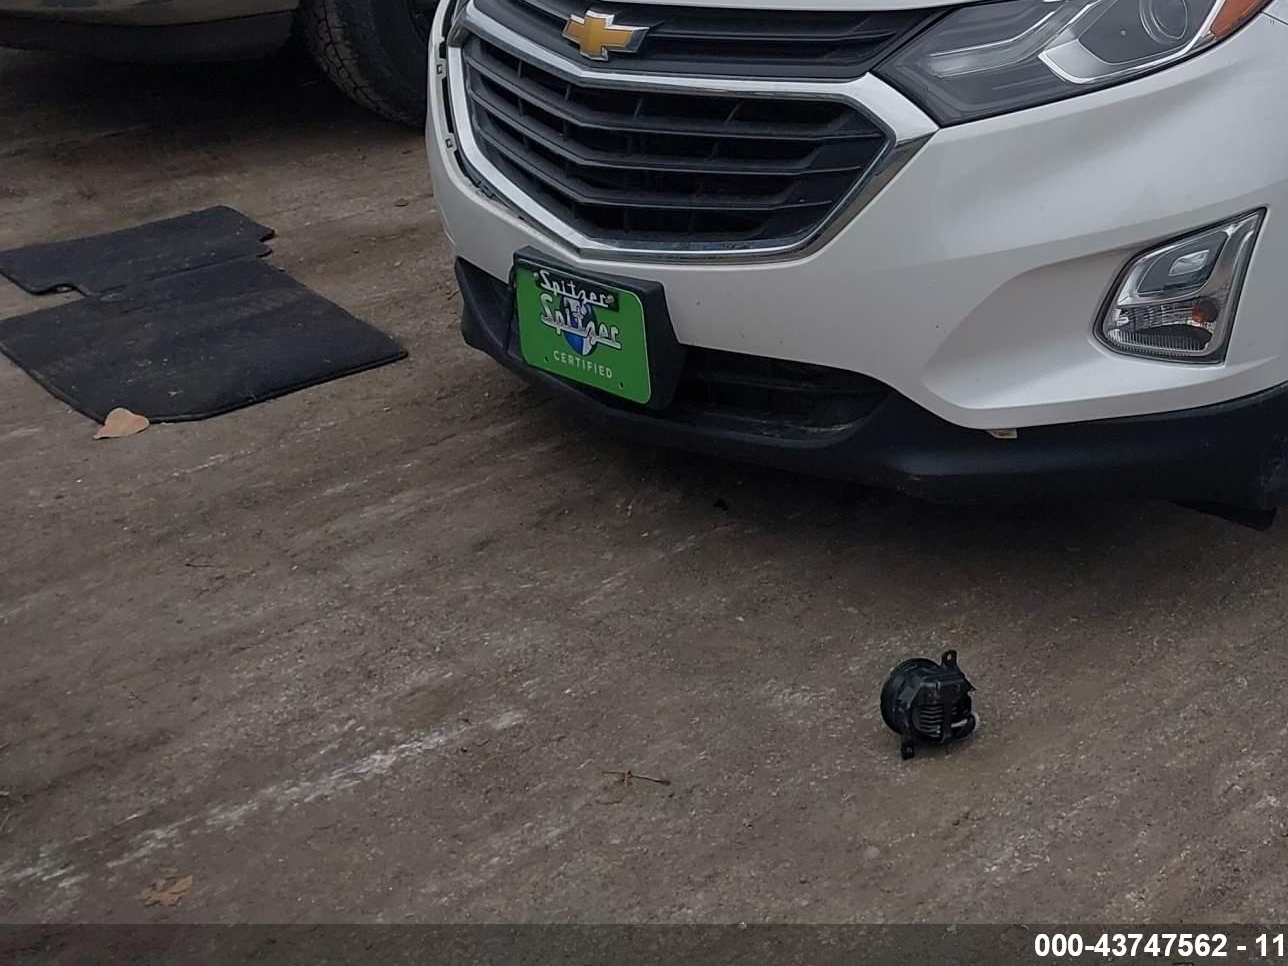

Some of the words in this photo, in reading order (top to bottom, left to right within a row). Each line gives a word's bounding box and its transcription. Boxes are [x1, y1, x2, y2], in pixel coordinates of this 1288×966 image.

[540, 269, 609, 308] Spitzer
[539, 292, 622, 350] Spitzer
[553, 350, 613, 379] CERTIFIED
